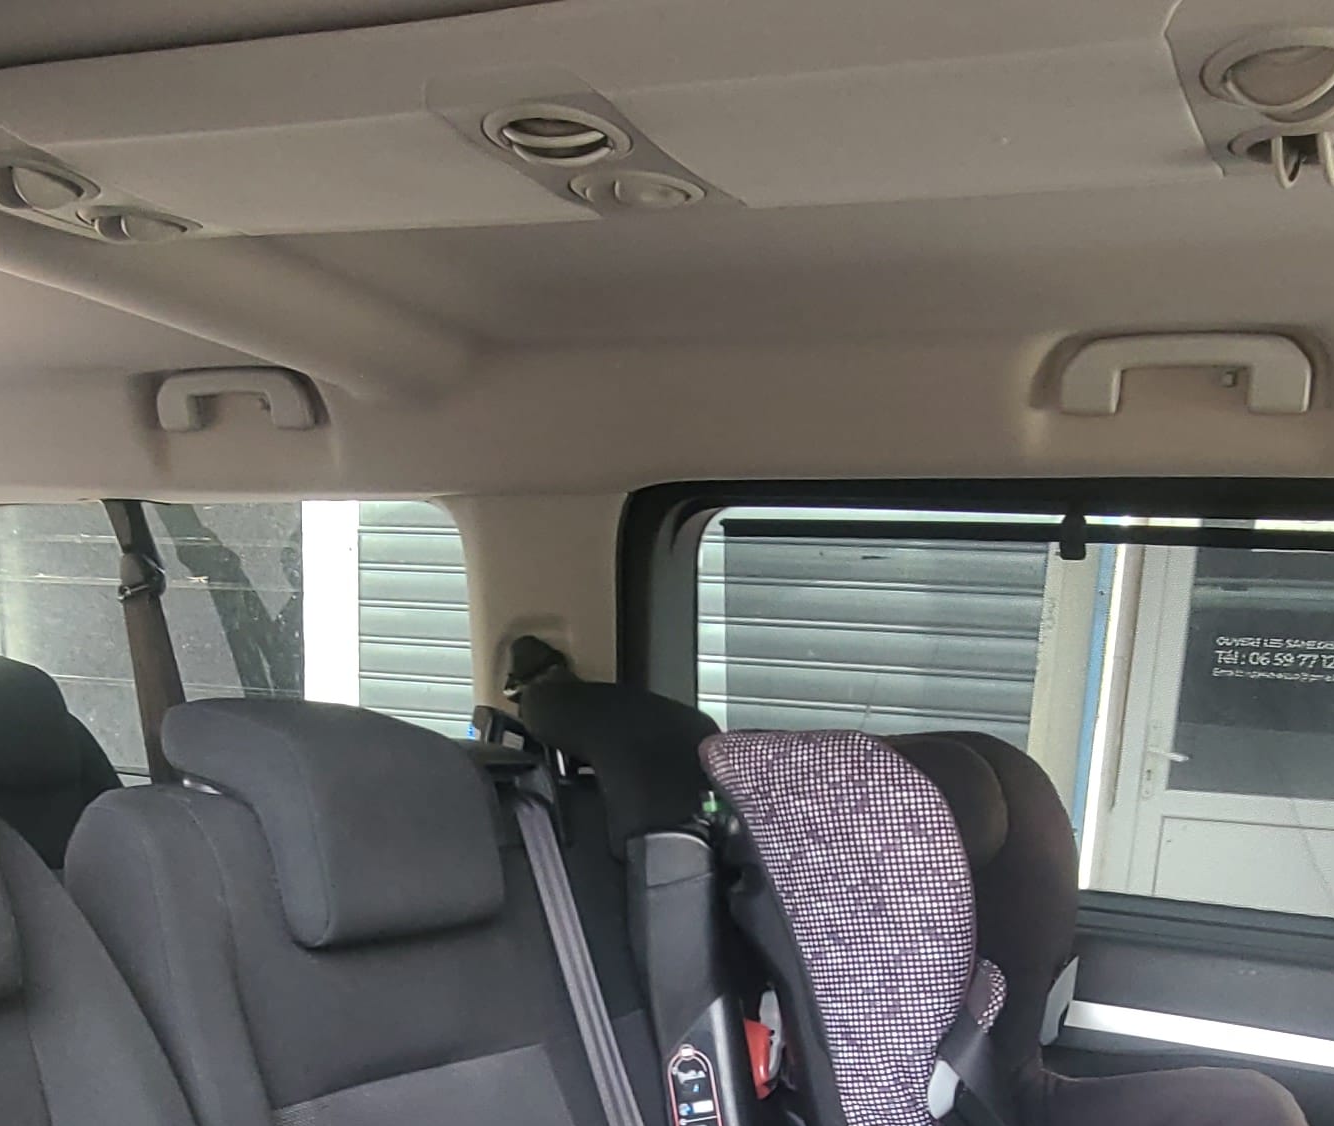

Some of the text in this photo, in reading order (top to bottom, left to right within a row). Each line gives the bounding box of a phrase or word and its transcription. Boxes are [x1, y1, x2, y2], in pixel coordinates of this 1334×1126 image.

[1248, 651, 1271, 666] 06
[1272, 652, 1295, 667] 59
[1296, 653, 1319, 669] 77
